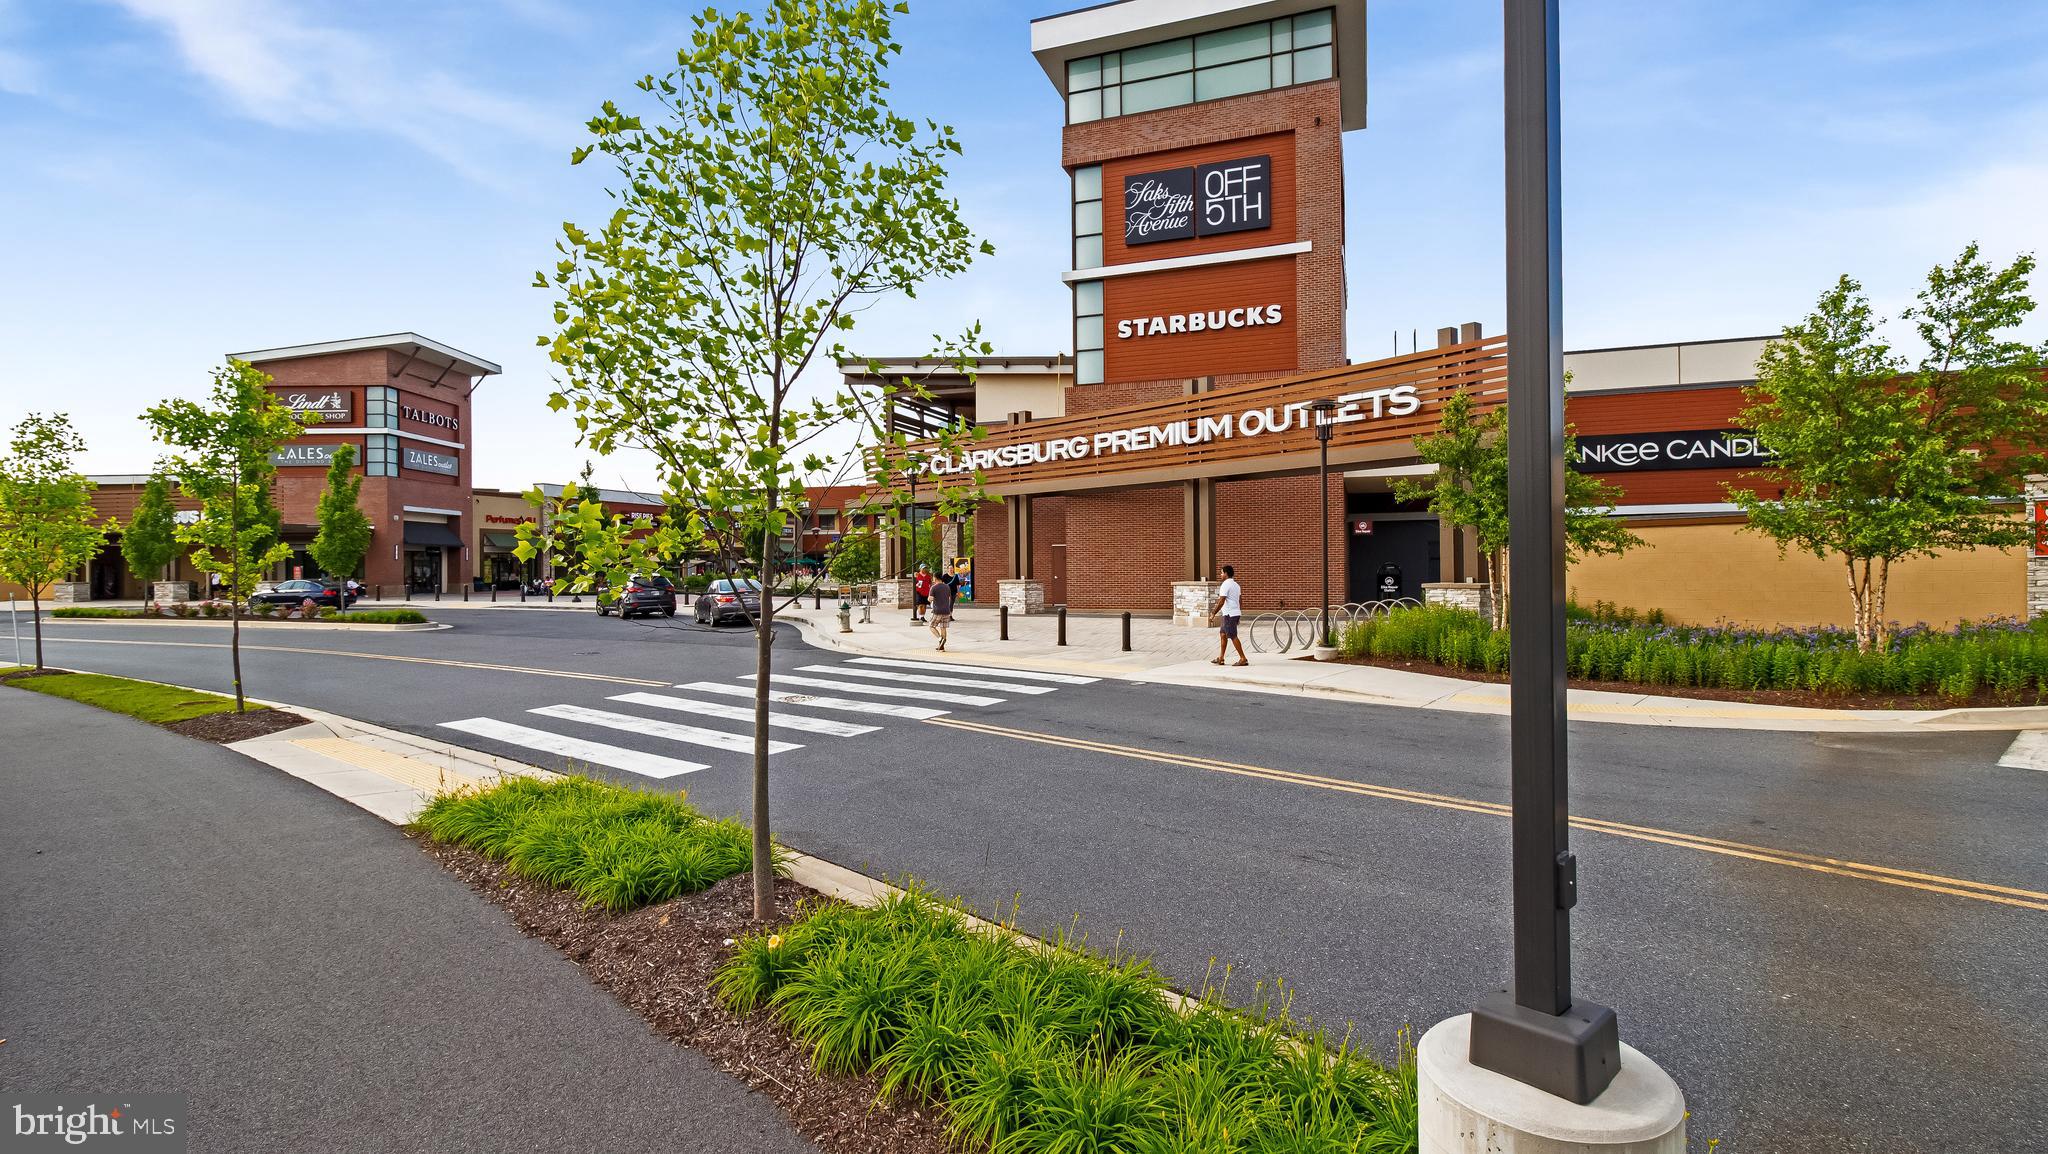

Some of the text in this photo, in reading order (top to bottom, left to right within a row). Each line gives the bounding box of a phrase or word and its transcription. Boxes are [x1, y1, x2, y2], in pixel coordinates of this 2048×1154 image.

[1205, 164, 1261, 198] OFF
[1125, 180, 1170, 209] Saks
[1206, 192, 1262, 226] 5TH
[1125, 212, 1188, 238] Avenue
[1117, 304, 1282, 339] STARBUCKS
[286, 393, 330, 409] Lindt
[325, 412, 346, 420] SHOP
[403, 405, 459, 430] TALBOTS
[930, 385, 1421, 476] CLARKSBURG PREMIUM OUTLETS
[410, 451, 438, 467] ZALES
[1666, 438, 1779, 460] CANDL
